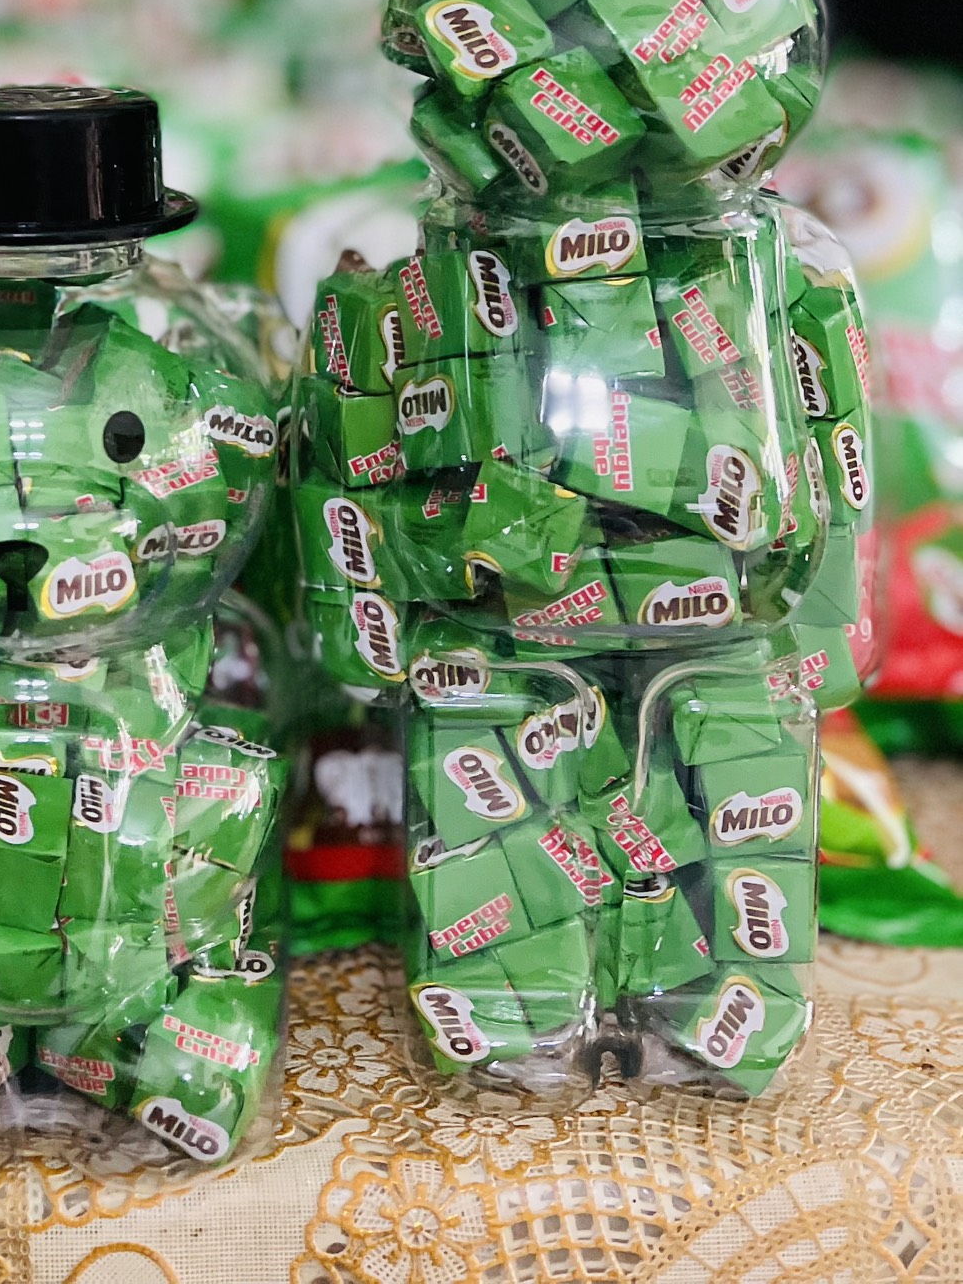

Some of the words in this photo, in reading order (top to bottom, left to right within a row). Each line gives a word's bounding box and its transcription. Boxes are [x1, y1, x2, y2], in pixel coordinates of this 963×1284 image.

[443, 8, 500, 68] MILO
[659, 12, 710, 63] Cube
[530, 69, 620, 145] Energy
[679, 54, 733, 105] Cube
[683, 59, 756, 132] Energy
[530, 91, 594, 145] Cube
[561, 230, 629, 262] MILO
[399, 268, 424, 330] Cube
[476, 255, 505, 328] MILO
[673, 310, 716, 364] Cube
[682, 286, 741, 365] Energy
[210, 415, 273, 445] MILO
[402, 388, 446, 417] MILO
[612, 392, 633, 491] Energy
[842, 435, 862, 501] MILO
[714, 457, 745, 535] MILO
[337, 506, 367, 576] MILO
[57, 569, 127, 604] MILO
[654, 593, 728, 623] MILO
[364, 601, 395, 669] MILO
[81, 777, 103, 822] MILO
[181, 765, 247, 784] Cube
[459, 754, 511, 811] MILO
[721, 805, 792, 833] MILO
[430, 894, 512, 950] Energy
[449, 918, 511, 957] Cube
[742, 882, 771, 950] MILO
[425, 993, 472, 1055] MILO
[707, 990, 754, 1057] MILO
[148, 1106, 219, 1155] MILO
